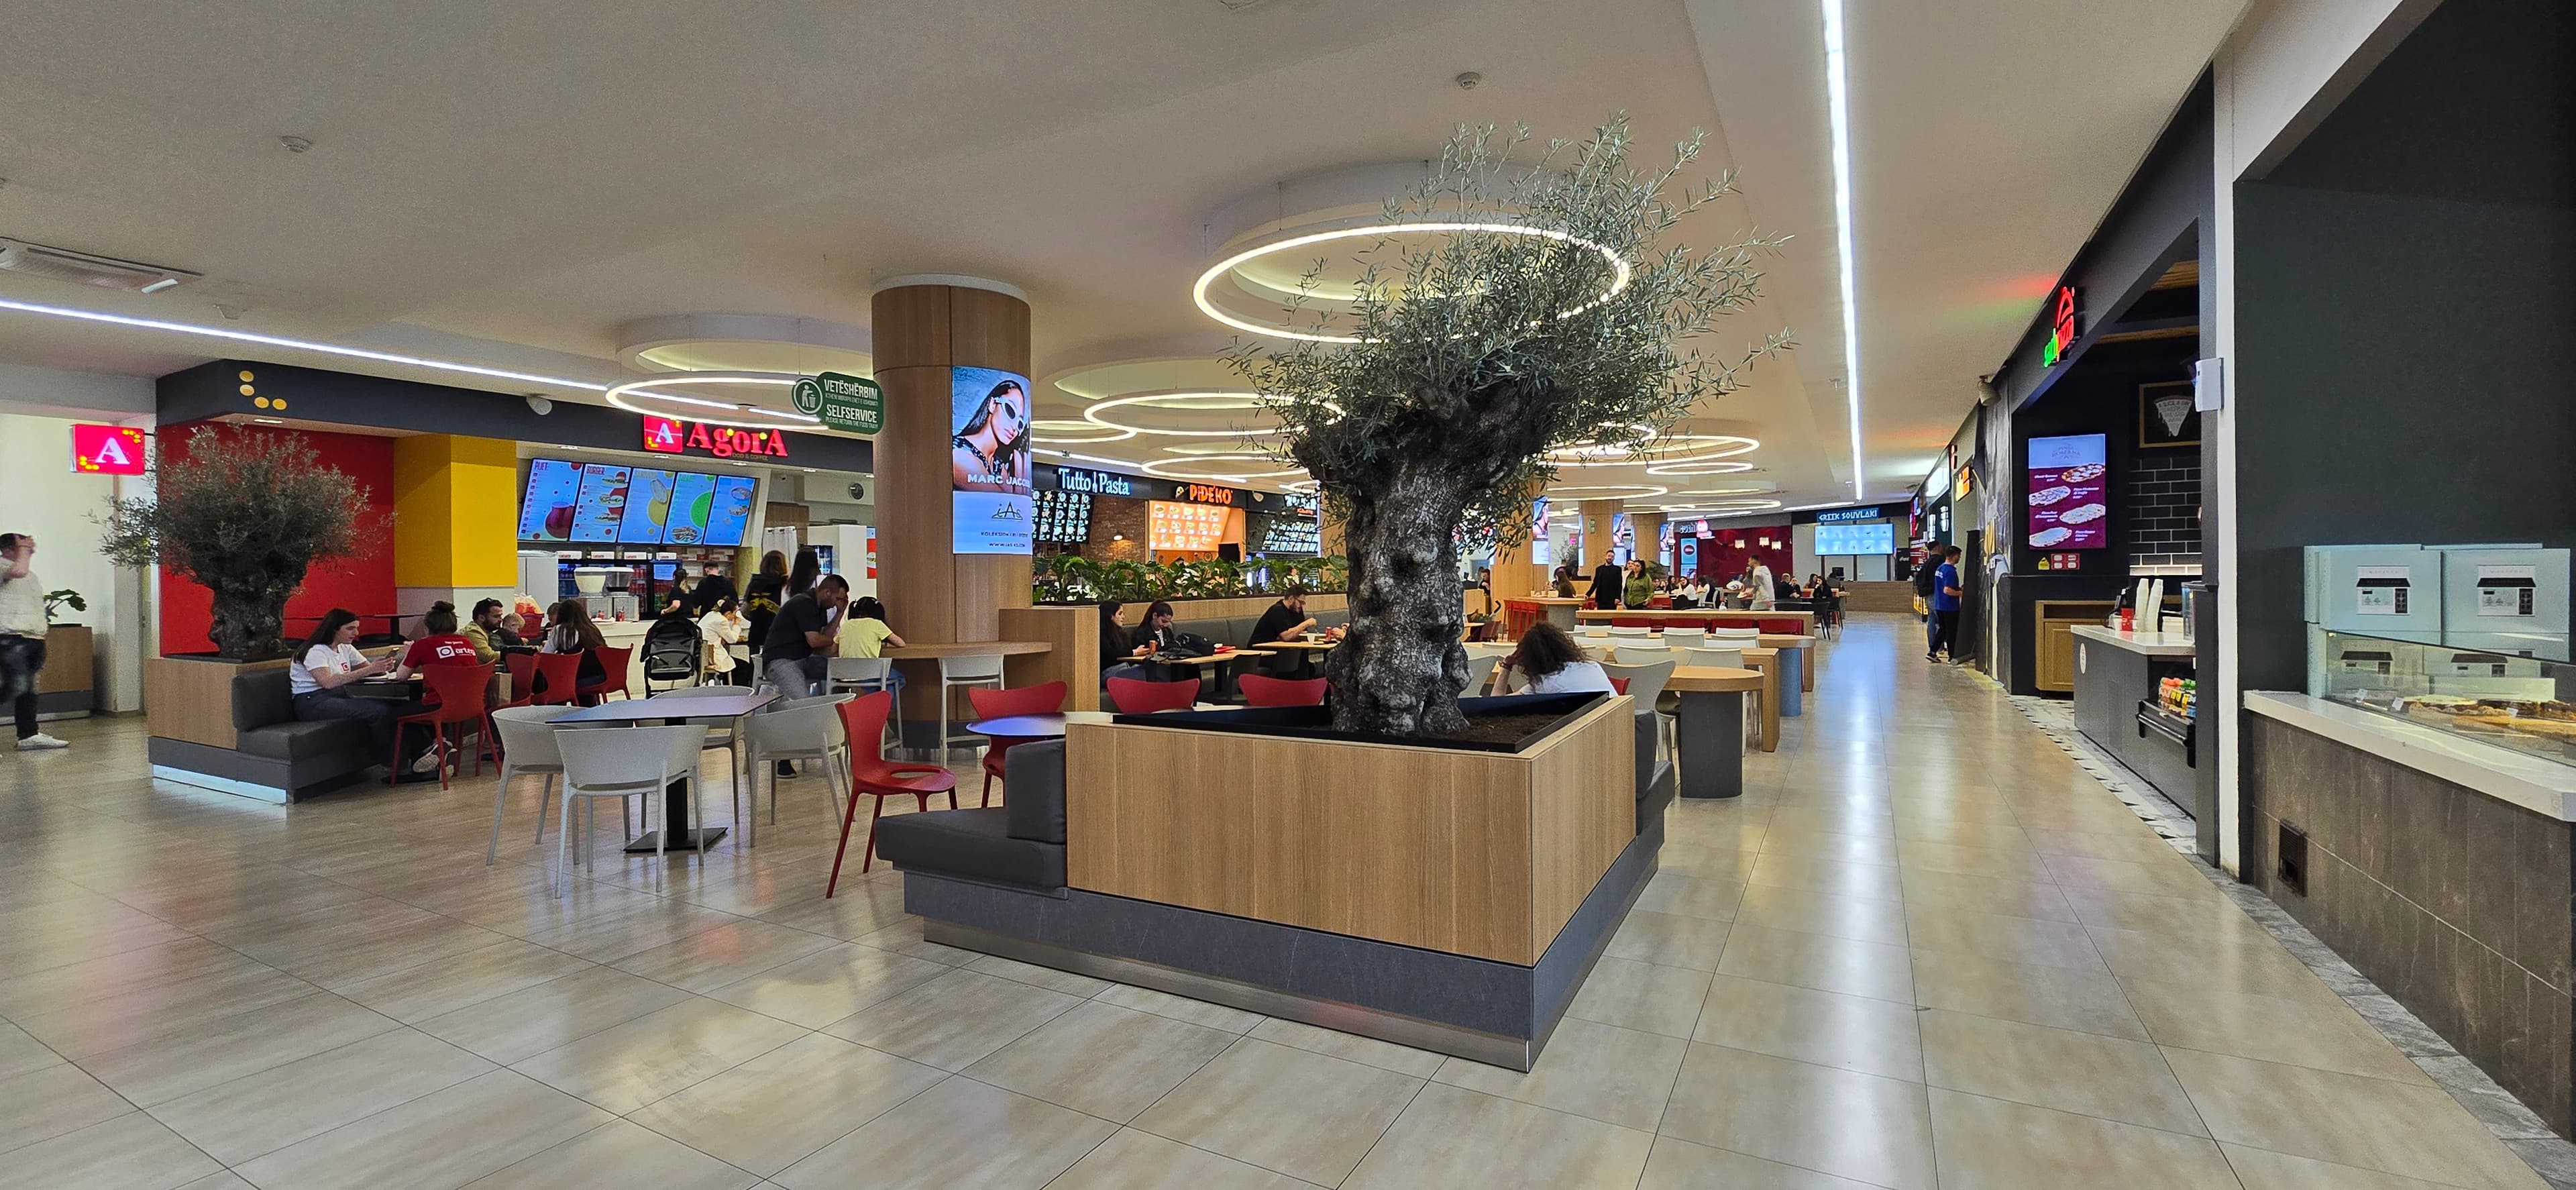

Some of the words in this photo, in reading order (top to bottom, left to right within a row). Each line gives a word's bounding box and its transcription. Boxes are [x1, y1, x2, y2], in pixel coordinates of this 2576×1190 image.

[824, 379, 878, 400] VETËSHËRBIM
[826, 404, 877, 423] SELFSERVICE
[95, 437, 130, 464] A
[967, 474, 1004, 484] MARC
[1058, 468, 1091, 491] Tutto
[1098, 472, 1130, 495] Pasta
